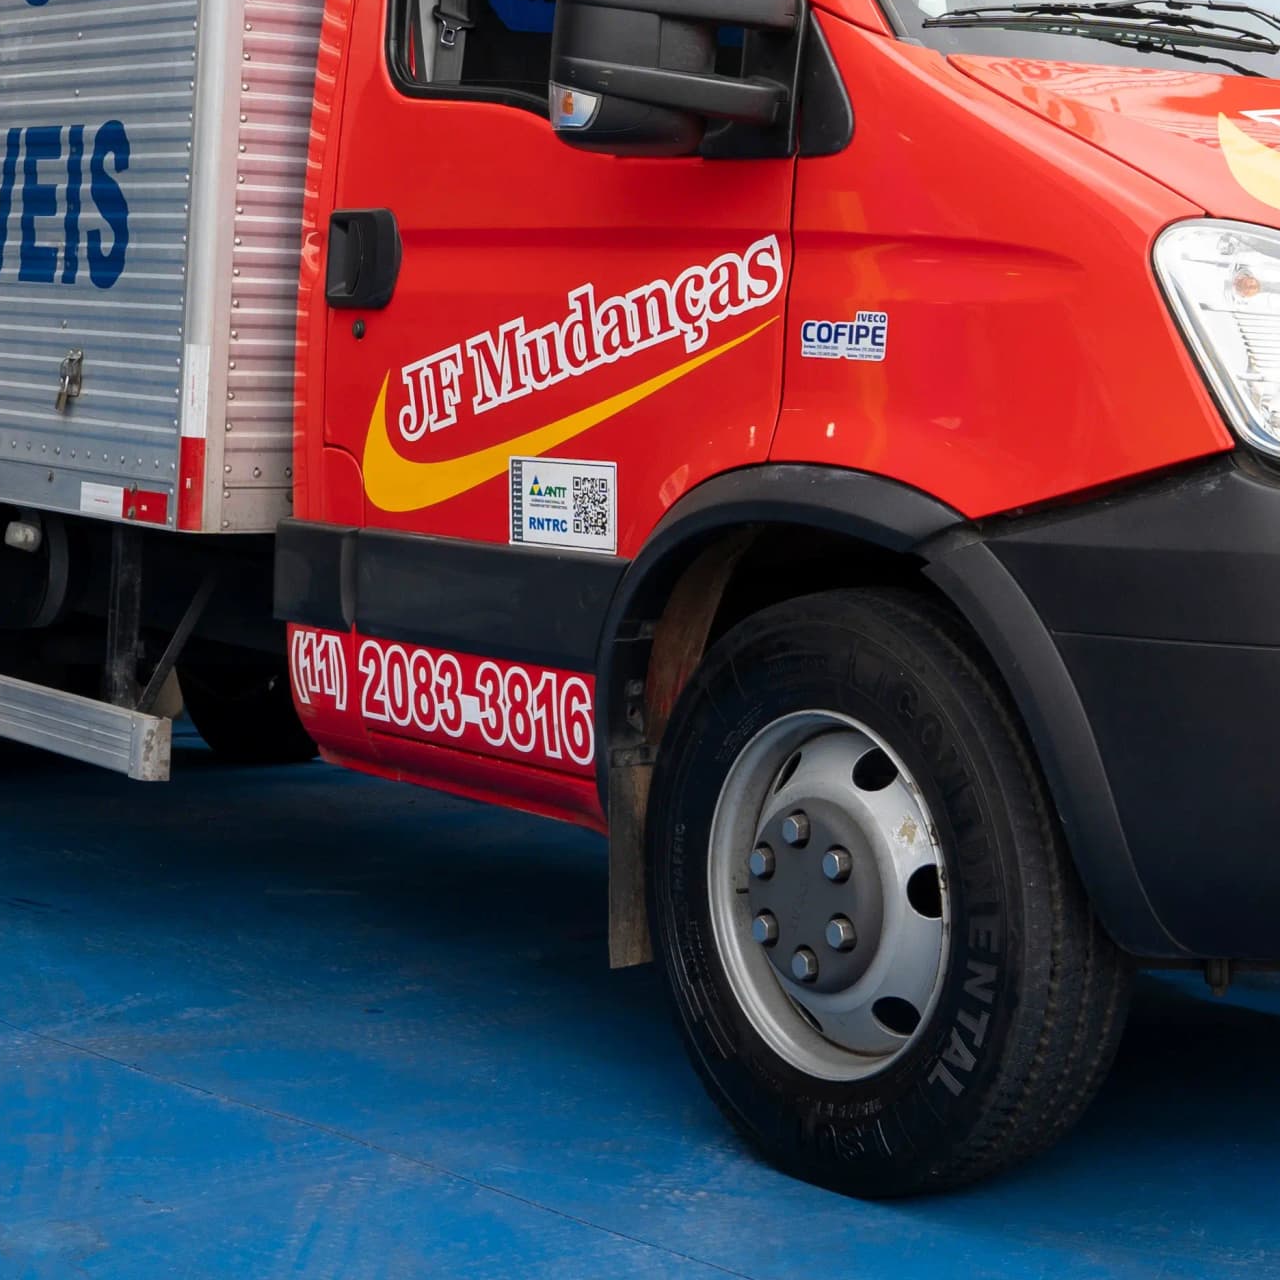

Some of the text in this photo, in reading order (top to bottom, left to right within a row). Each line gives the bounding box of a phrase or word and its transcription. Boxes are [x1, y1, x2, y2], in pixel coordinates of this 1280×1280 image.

[857, 313, 887, 323] IVECO
[398, 234, 784, 442] JF Mudanças
[802, 321, 886, 347] COFIPE
[543, 485, 567, 499] ANTT
[528, 516, 568, 533] RNTRC
[291, 630, 348, 711] (11)
[358, 640, 596, 766] 2083-3816
